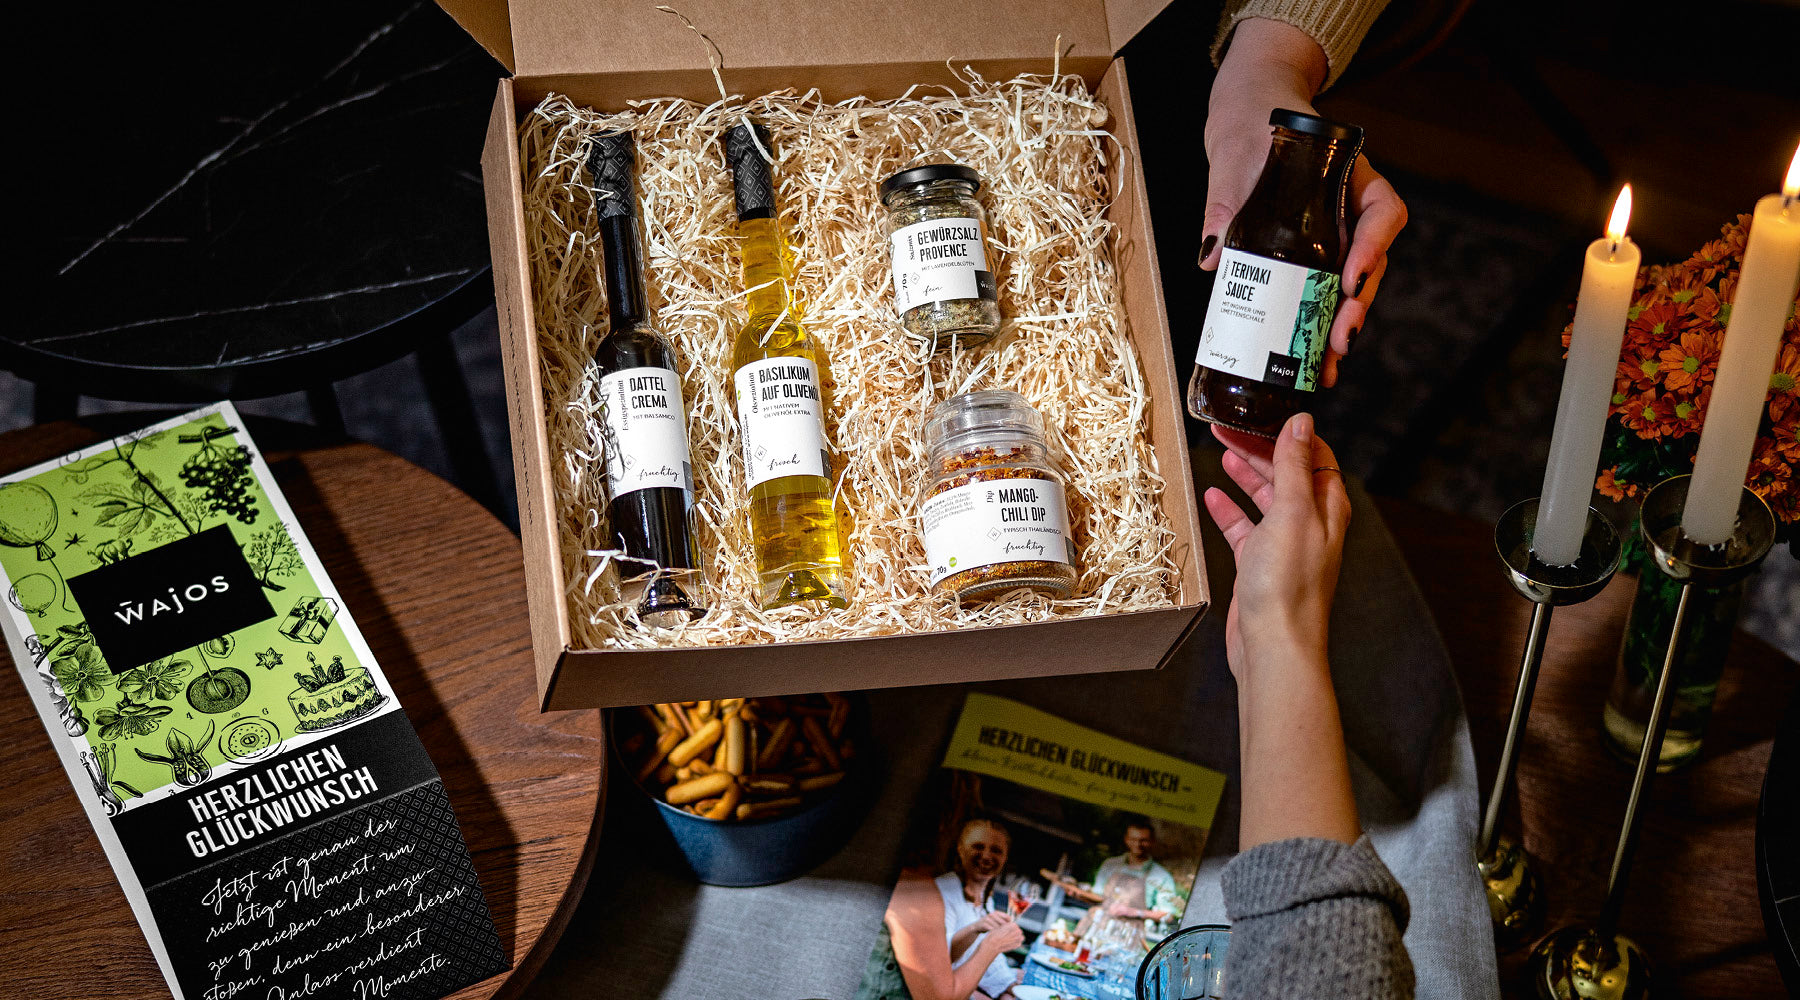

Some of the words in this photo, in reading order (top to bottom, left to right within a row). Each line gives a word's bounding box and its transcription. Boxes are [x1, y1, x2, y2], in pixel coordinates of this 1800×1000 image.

[917, 227, 979, 245] GEWÜRZSALZ
[920, 243, 967, 262] PROVENCE
[1230, 261, 1272, 285] TERIYAKI
[1225, 281, 1255, 301] SAUCE
[1230, 303, 1251, 313] INGWER
[1252, 308, 1266, 316] UND
[629, 376, 667, 392] DATTEL
[759, 365, 810, 384] BASILIKUM
[631, 395, 668, 409] CREMA
[762, 385, 780, 402] AUF
[998, 488, 1039, 504] MANGO-
[1001, 507, 1029, 523] CHILI
[1031, 507, 1046, 522] DIP
[978, 726, 1068, 765] HERZLICHEN
[1070, 748, 1180, 793] GLÜCKWUNSCH
[187, 744, 347, 823] HERZLICHEN
[185, 766, 378, 858] GLÜCKWUNSCH
[201, 870, 260, 915] Jetzt
[262, 856, 293, 881] ist
[296, 835, 359, 879] genau
[363, 817, 398, 838] der
[206, 899, 287, 942] richtige
[379, 842, 416, 861] um
[208, 955, 234, 980] zu
[238, 917, 322, 970] genießen
[324, 887, 370, 917] und
[272, 950, 319, 975] denn
[321, 933, 357, 952] ein
[359, 886, 465, 938] besonderer
[345, 927, 427, 975] verdient
